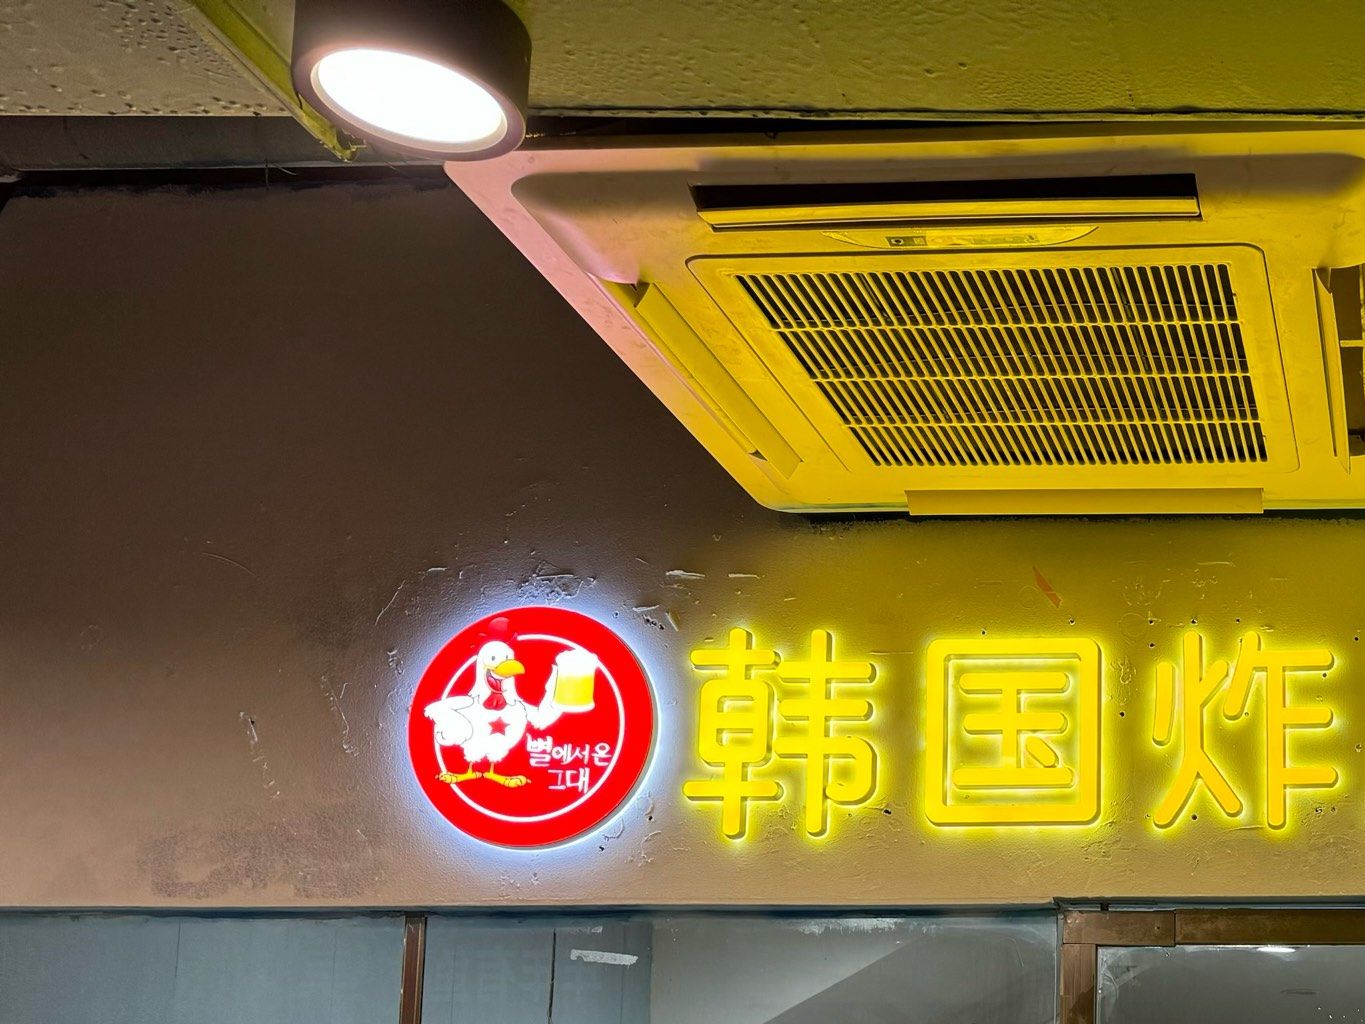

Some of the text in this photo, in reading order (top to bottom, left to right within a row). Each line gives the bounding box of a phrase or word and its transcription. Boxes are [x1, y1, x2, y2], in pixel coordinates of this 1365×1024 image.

[526, 732, 612, 767] 별에서 온
[547, 767, 591, 794] 그대
